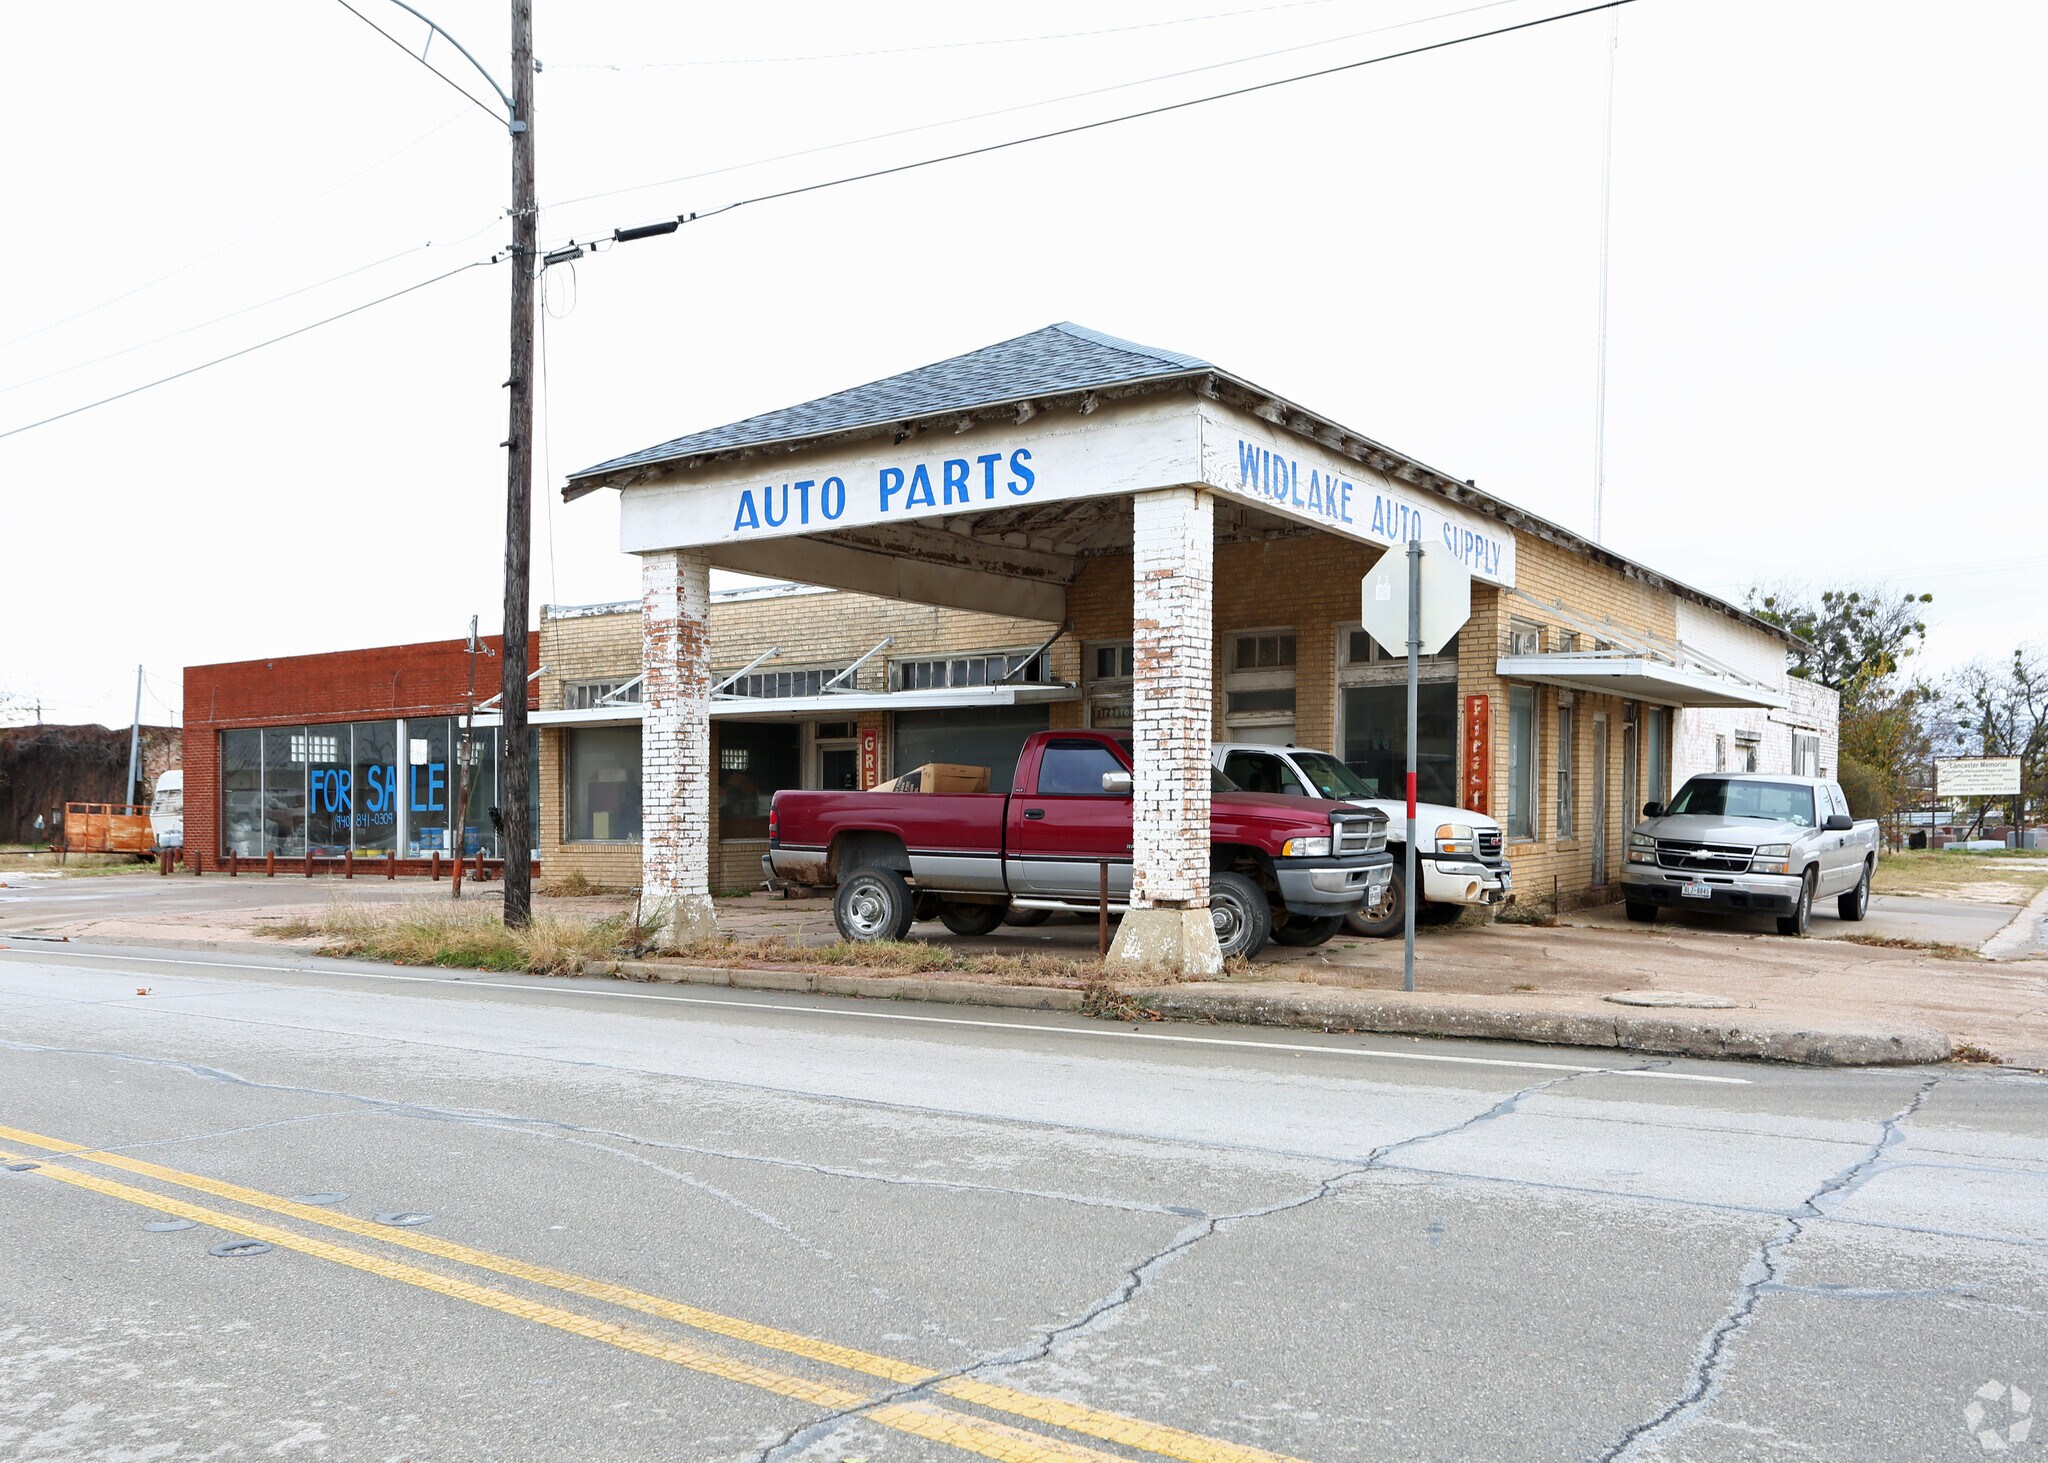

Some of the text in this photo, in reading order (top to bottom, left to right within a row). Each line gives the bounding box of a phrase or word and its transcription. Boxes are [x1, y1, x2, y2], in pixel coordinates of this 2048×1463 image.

[733, 447, 1036, 532] AUTO PARTS
[1238, 439, 1501, 576] WIDLAKE AUTO SUPPLY
[1094, 707, 1133, 718] Firesto
[311, 763, 445, 814] FOR SALE
[333, 812, 393, 831] (940) 841-0309
